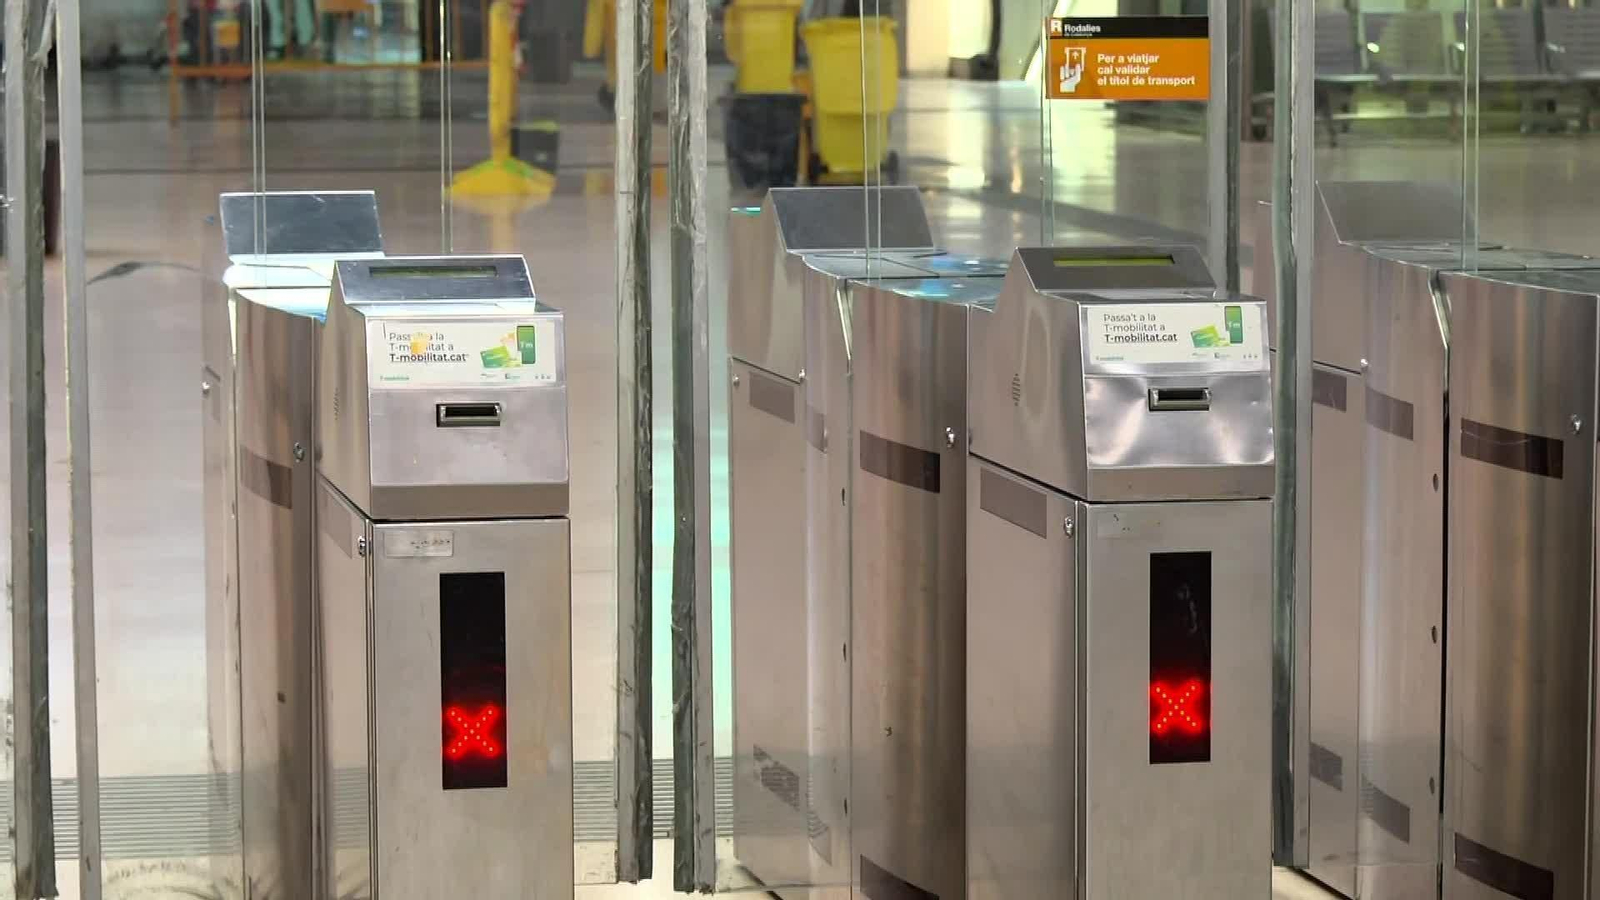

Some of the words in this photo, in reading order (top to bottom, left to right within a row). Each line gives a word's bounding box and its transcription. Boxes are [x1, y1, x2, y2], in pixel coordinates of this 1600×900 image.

[1064, 23, 1101, 33] Rodalies
[1097, 53, 1115, 64] Per
[1118, 56, 1125, 64] a
[1127, 53, 1160, 65] viatjar
[1097, 65, 1113, 75] cal
[1115, 65, 1150, 75] validar
[1097, 76, 1107, 86] el
[1132, 76, 1145, 86] de
[1147, 76, 1196, 87] transport
[1103, 313, 1137, 322] Passa't
[1147, 313, 1156, 321] la
[1104, 323, 1157, 332] T-mobilitat
[435, 332, 444, 340] la
[1104, 333, 1177, 343] T-mobilitat.cat
